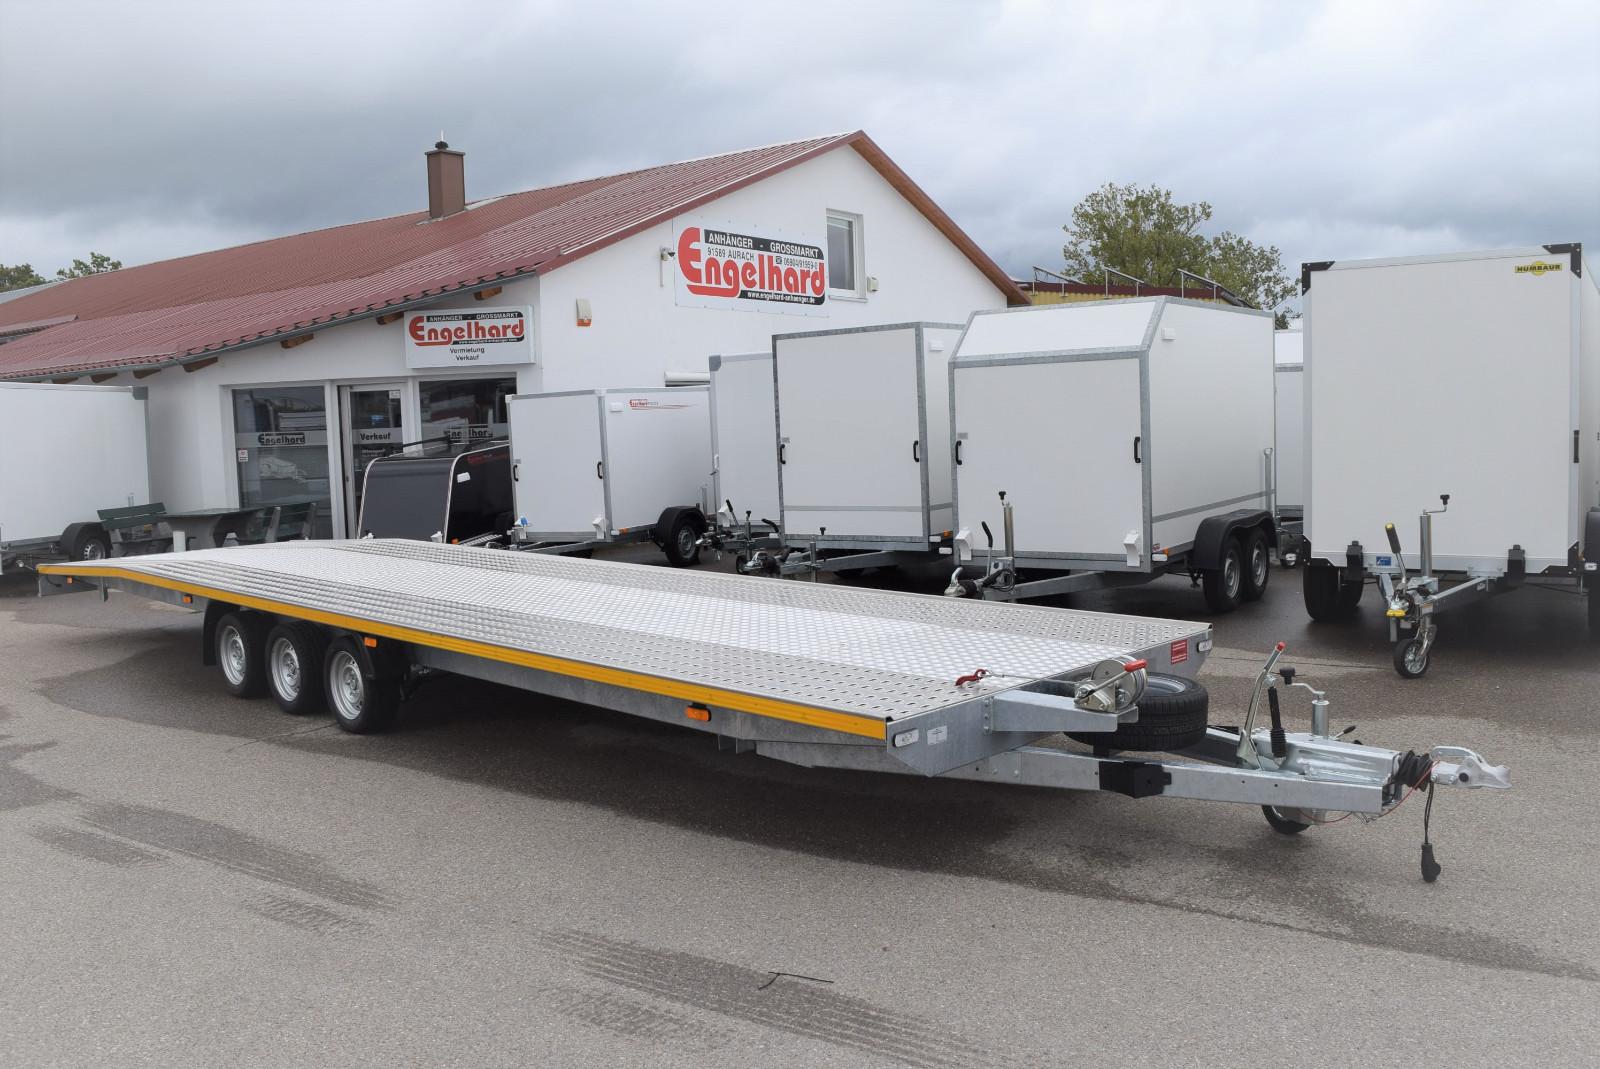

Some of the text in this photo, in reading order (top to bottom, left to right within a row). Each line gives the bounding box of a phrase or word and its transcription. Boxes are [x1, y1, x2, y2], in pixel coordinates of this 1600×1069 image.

[708, 232, 753, 249] ANHÄNGER
[770, 242, 818, 258] GROSSMARKT
[728, 249, 754, 261] AURACH
[678, 227, 825, 298] Engelhard
[1517, 264, 1561, 272] HUMBAUR
[476, 312, 519, 320] GROSSMARKT
[409, 316, 524, 346] Engelhard
[258, 433, 305, 446] Engelhard
[360, 432, 391, 441] Verkauf
